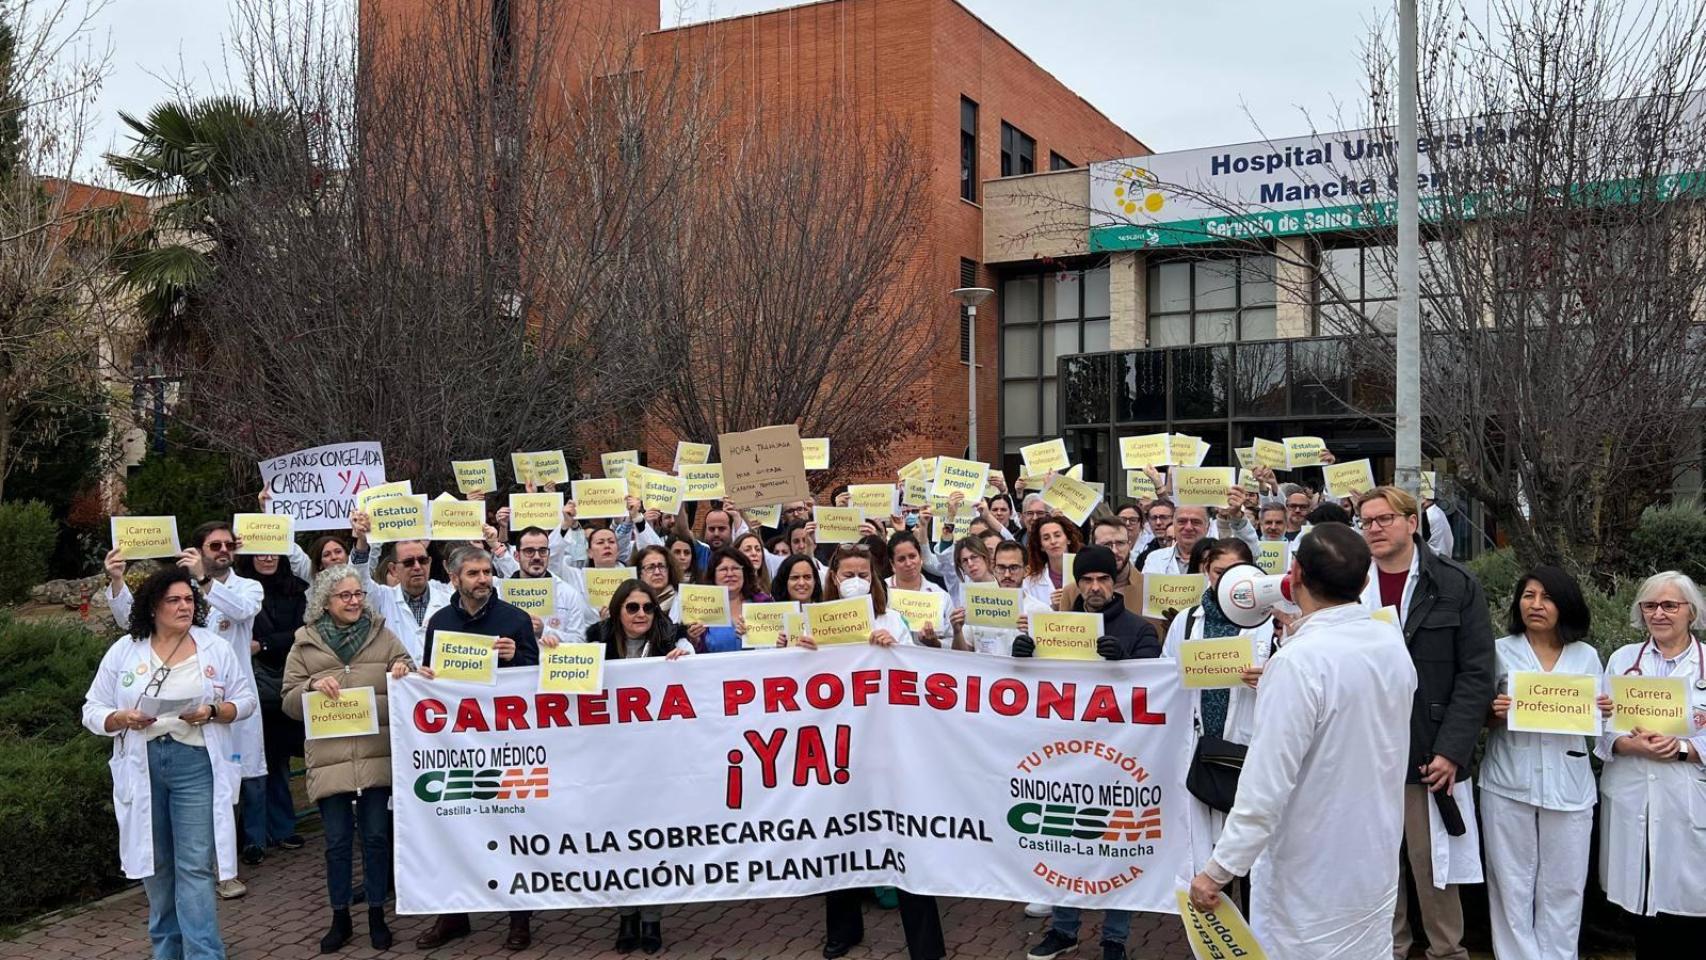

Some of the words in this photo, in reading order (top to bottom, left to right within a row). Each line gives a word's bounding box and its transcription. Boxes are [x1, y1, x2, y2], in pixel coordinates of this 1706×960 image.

[1211, 142, 1332, 176] Hospital
[1260, 176, 1377, 204] Mancha
[1206, 216, 1274, 239] Servicio
[1279, 214, 1299, 232] de
[1304, 206, 1353, 231] Salud
[730, 445, 751, 455] HORA
[267, 459, 288, 471] 13
[290, 452, 320, 469] AÑOS
[320, 448, 383, 467] CONGELADA
[944, 466, 979, 479] ¡Estatuo
[271, 471, 325, 494] CARRERA
[338, 470, 370, 495] YA
[688, 482, 718, 491] propio!
[944, 478, 975, 489] propio!
[1186, 476, 1221, 485] ¡Carrera
[584, 488, 615, 496] ¡Carrera
[373, 505, 418, 517] ¡Estatuo
[246, 522, 280, 530] ¡Carrera
[378, 518, 417, 530] propio!
[126, 526, 161, 535] ¡Carrera
[118, 537, 172, 547] Profesional!
[507, 588, 548, 597] ¡Estatuo
[1159, 584, 1195, 593] ¡Carrera
[511, 598, 545, 608] propio!
[687, 594, 715, 603] ¡Carrera
[899, 598, 931, 608] ¡Carrera
[971, 595, 1013, 606] ¡Estatuo
[682, 606, 724, 615] Profesional!
[819, 609, 858, 623] ¡Carrera
[975, 608, 1010, 618] propio!
[747, 624, 784, 632] Profesion
[812, 621, 868, 637] Profesional!
[1045, 623, 1086, 633] ¡Carrera
[1036, 637, 1096, 648] Profesional!
[442, 643, 488, 656] ¡Estatuo
[1194, 650, 1240, 661] ¡Carrera
[443, 657, 483, 670] propio!
[548, 654, 594, 665] ¡Estatuo
[550, 669, 589, 680] propio!
[1185, 663, 1251, 675] Profesional!
[1529, 684, 1579, 697] ¡Carrera
[1625, 687, 1672, 700] ¡Carrera
[319, 699, 359, 710] ¡Carrera
[413, 684, 697, 733] CARRERA
[722, 669, 1166, 725] PROFESIONAL
[1516, 700, 1591, 714] Profesional!
[311, 709, 370, 723] Profesional!
[1616, 703, 1683, 718] Profesional!
[412, 748, 486, 770] SINDICATO
[490, 742, 547, 767] MÉDICO
[1016, 751, 1043, 774] TU
[1043, 739, 1150, 784] PROFESIÓN
[726, 724, 851, 809] ¡YA!
[413, 767, 549, 802] CESM
[1010, 777, 1094, 805] SINDICATO
[1099, 780, 1162, 807] MÉDICO
[435, 805, 472, 816] Castilla
[479, 804, 490, 814] La
[492, 804, 525, 814] Mancha
[1007, 802, 1162, 842] CESM
[509, 833, 550, 856] NO
[558, 832, 578, 854] A
[585, 830, 621, 853] LA
[627, 817, 816, 851] SOBRECARGA
[823, 810, 994, 842] ASISTENCIAL
[1018, 836, 1094, 856] Castilla-La
[1099, 842, 1154, 858] Mancha
[509, 860, 695, 895] ADECUACIÓN
[704, 860, 739, 883] DE
[748, 847, 906, 882] PLANTILLAS
[1032, 861, 1144, 896] DEFIÉNDELA
